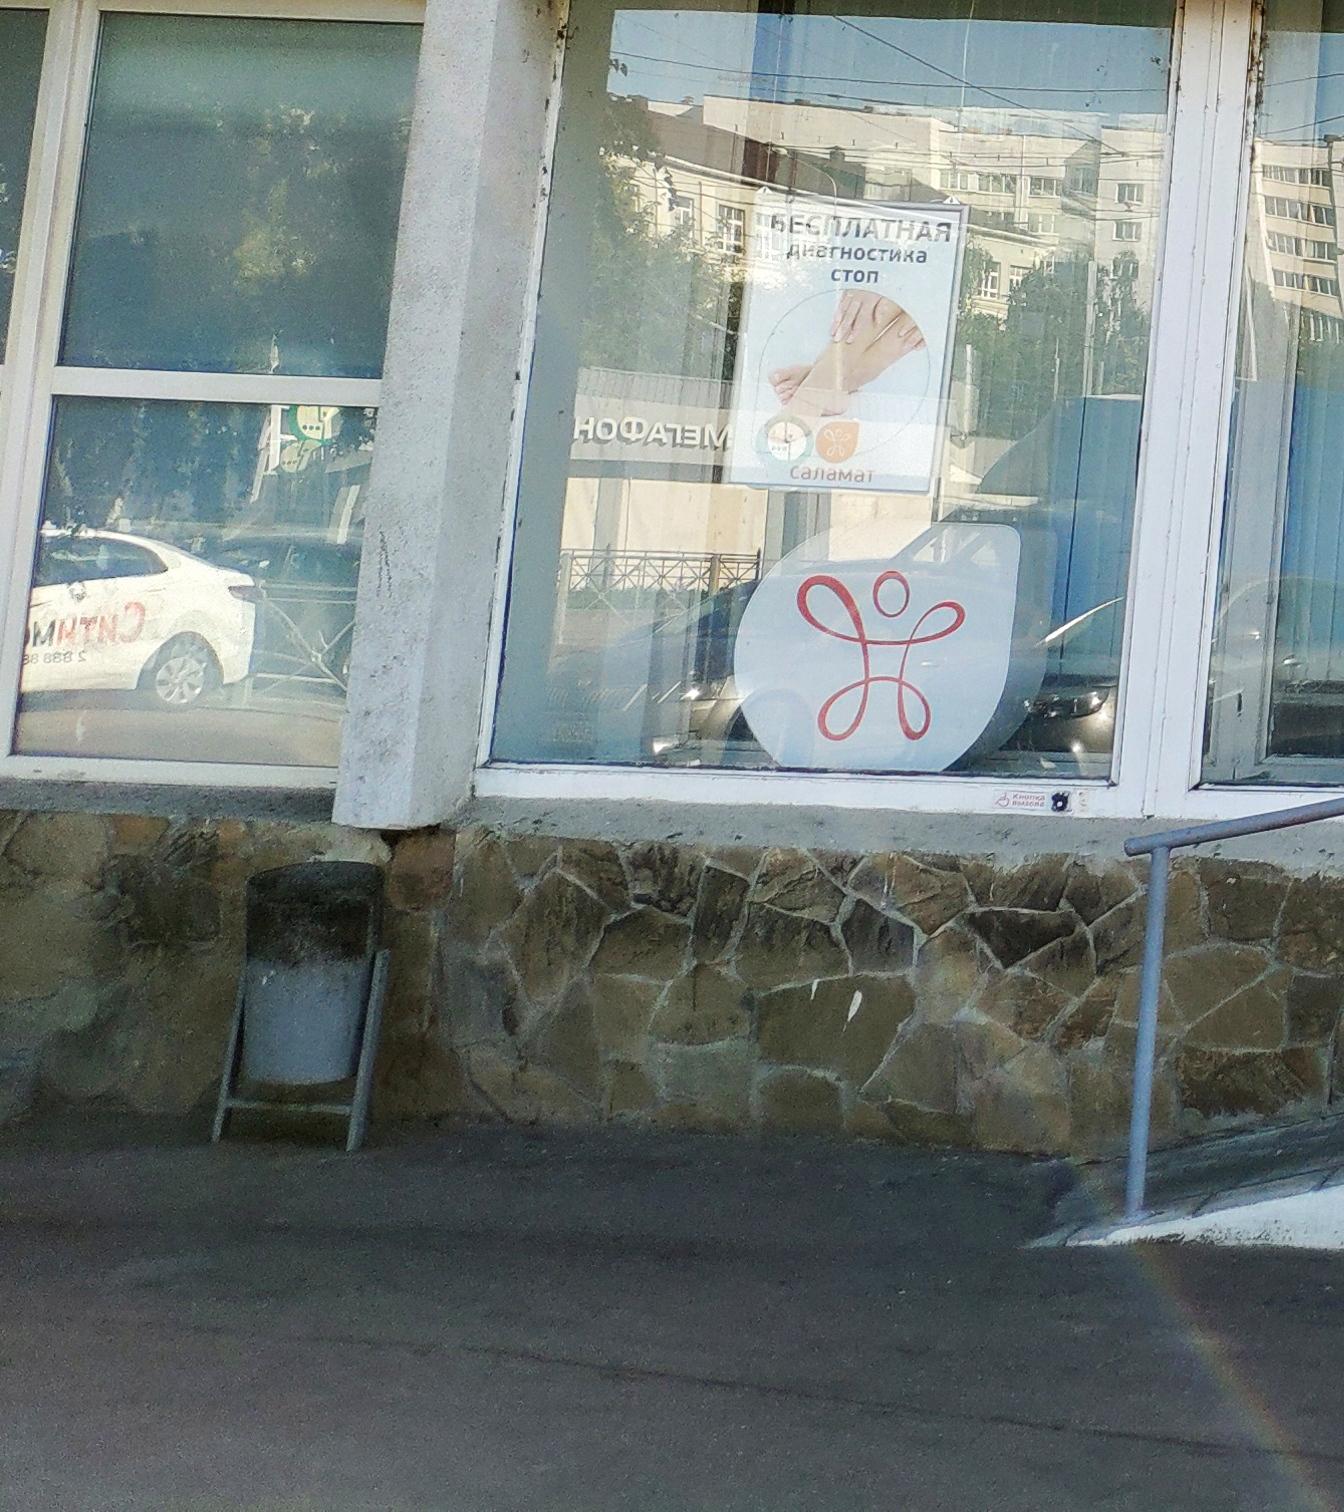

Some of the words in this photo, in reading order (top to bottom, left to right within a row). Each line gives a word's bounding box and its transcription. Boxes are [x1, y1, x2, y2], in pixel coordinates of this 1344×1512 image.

[771, 213, 951, 242] БЕСПЛАТНАЯ
[787, 243, 928, 264] диагностика
[830, 267, 879, 284] стоп
[790, 464, 875, 484] саламат
